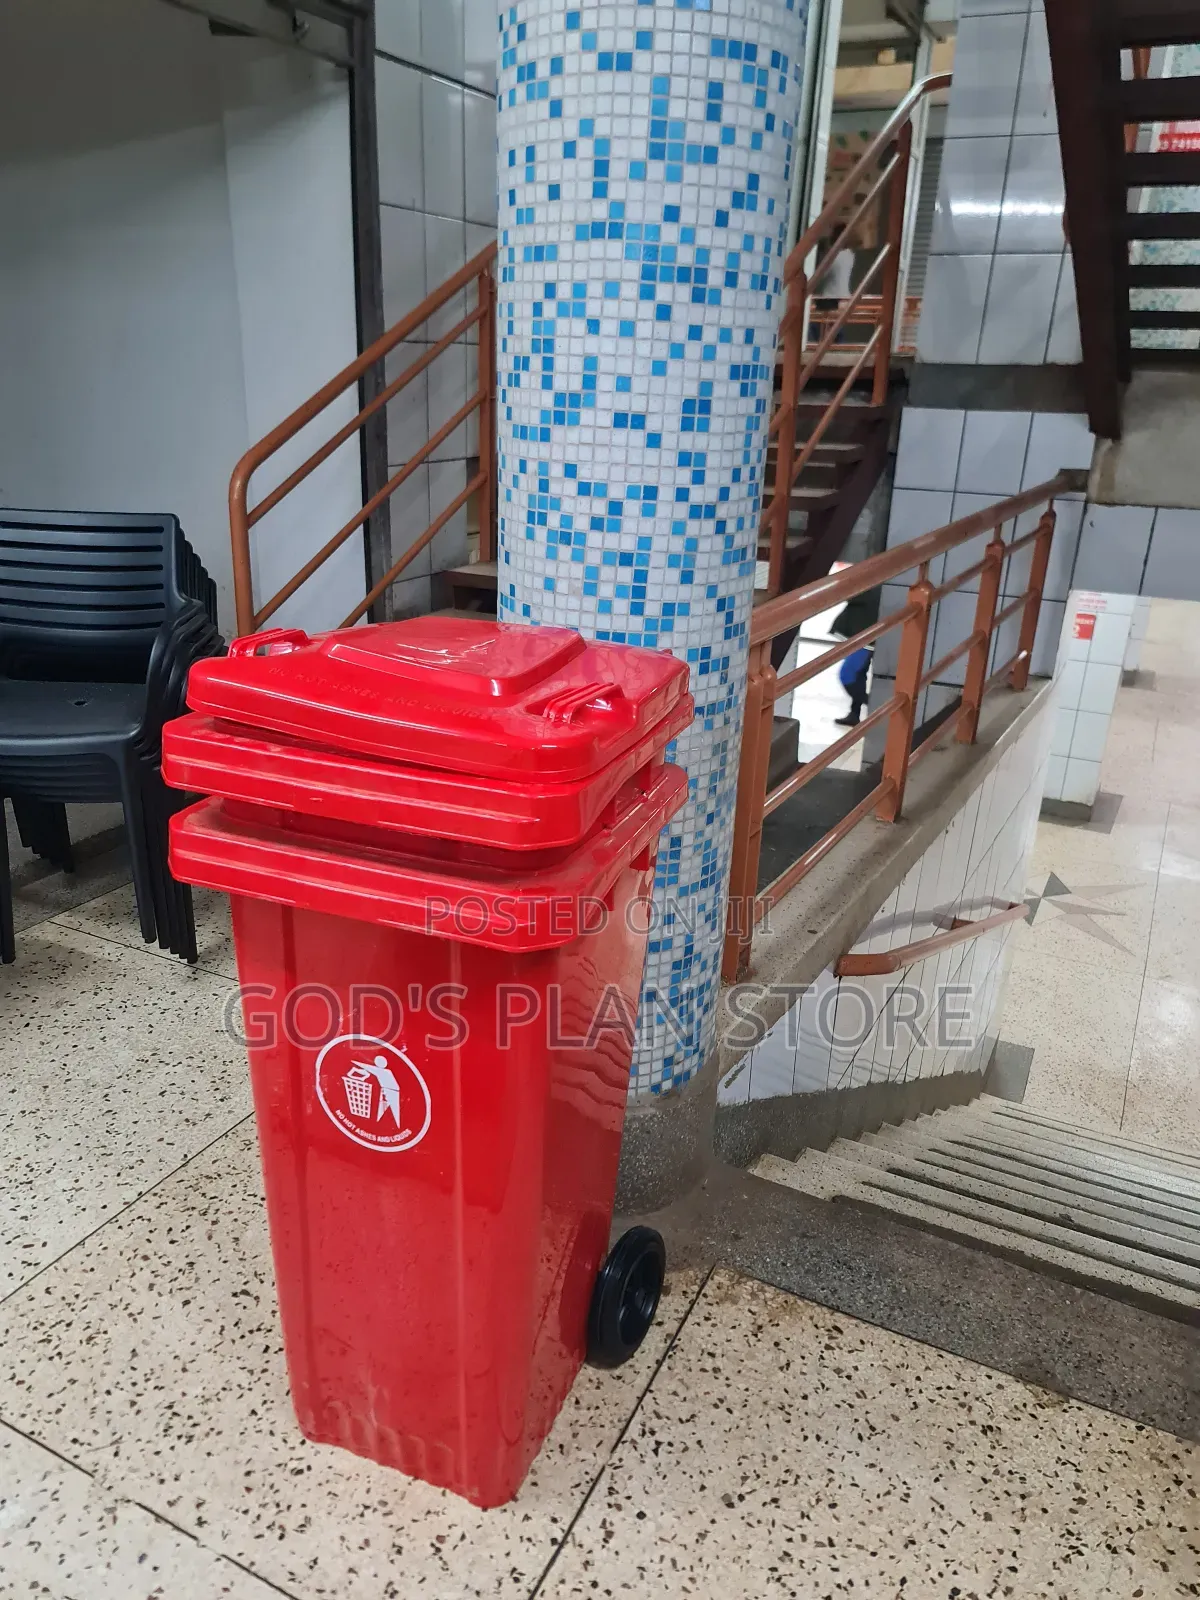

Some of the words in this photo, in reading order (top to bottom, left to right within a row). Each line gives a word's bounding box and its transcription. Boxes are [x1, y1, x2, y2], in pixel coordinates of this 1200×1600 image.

[335, 1109, 345, 1120] NO
[355, 1127, 377, 1141] ASHES
[376, 1135, 391, 1143] AND
[390, 1128, 412, 1143] LIQUIDS
